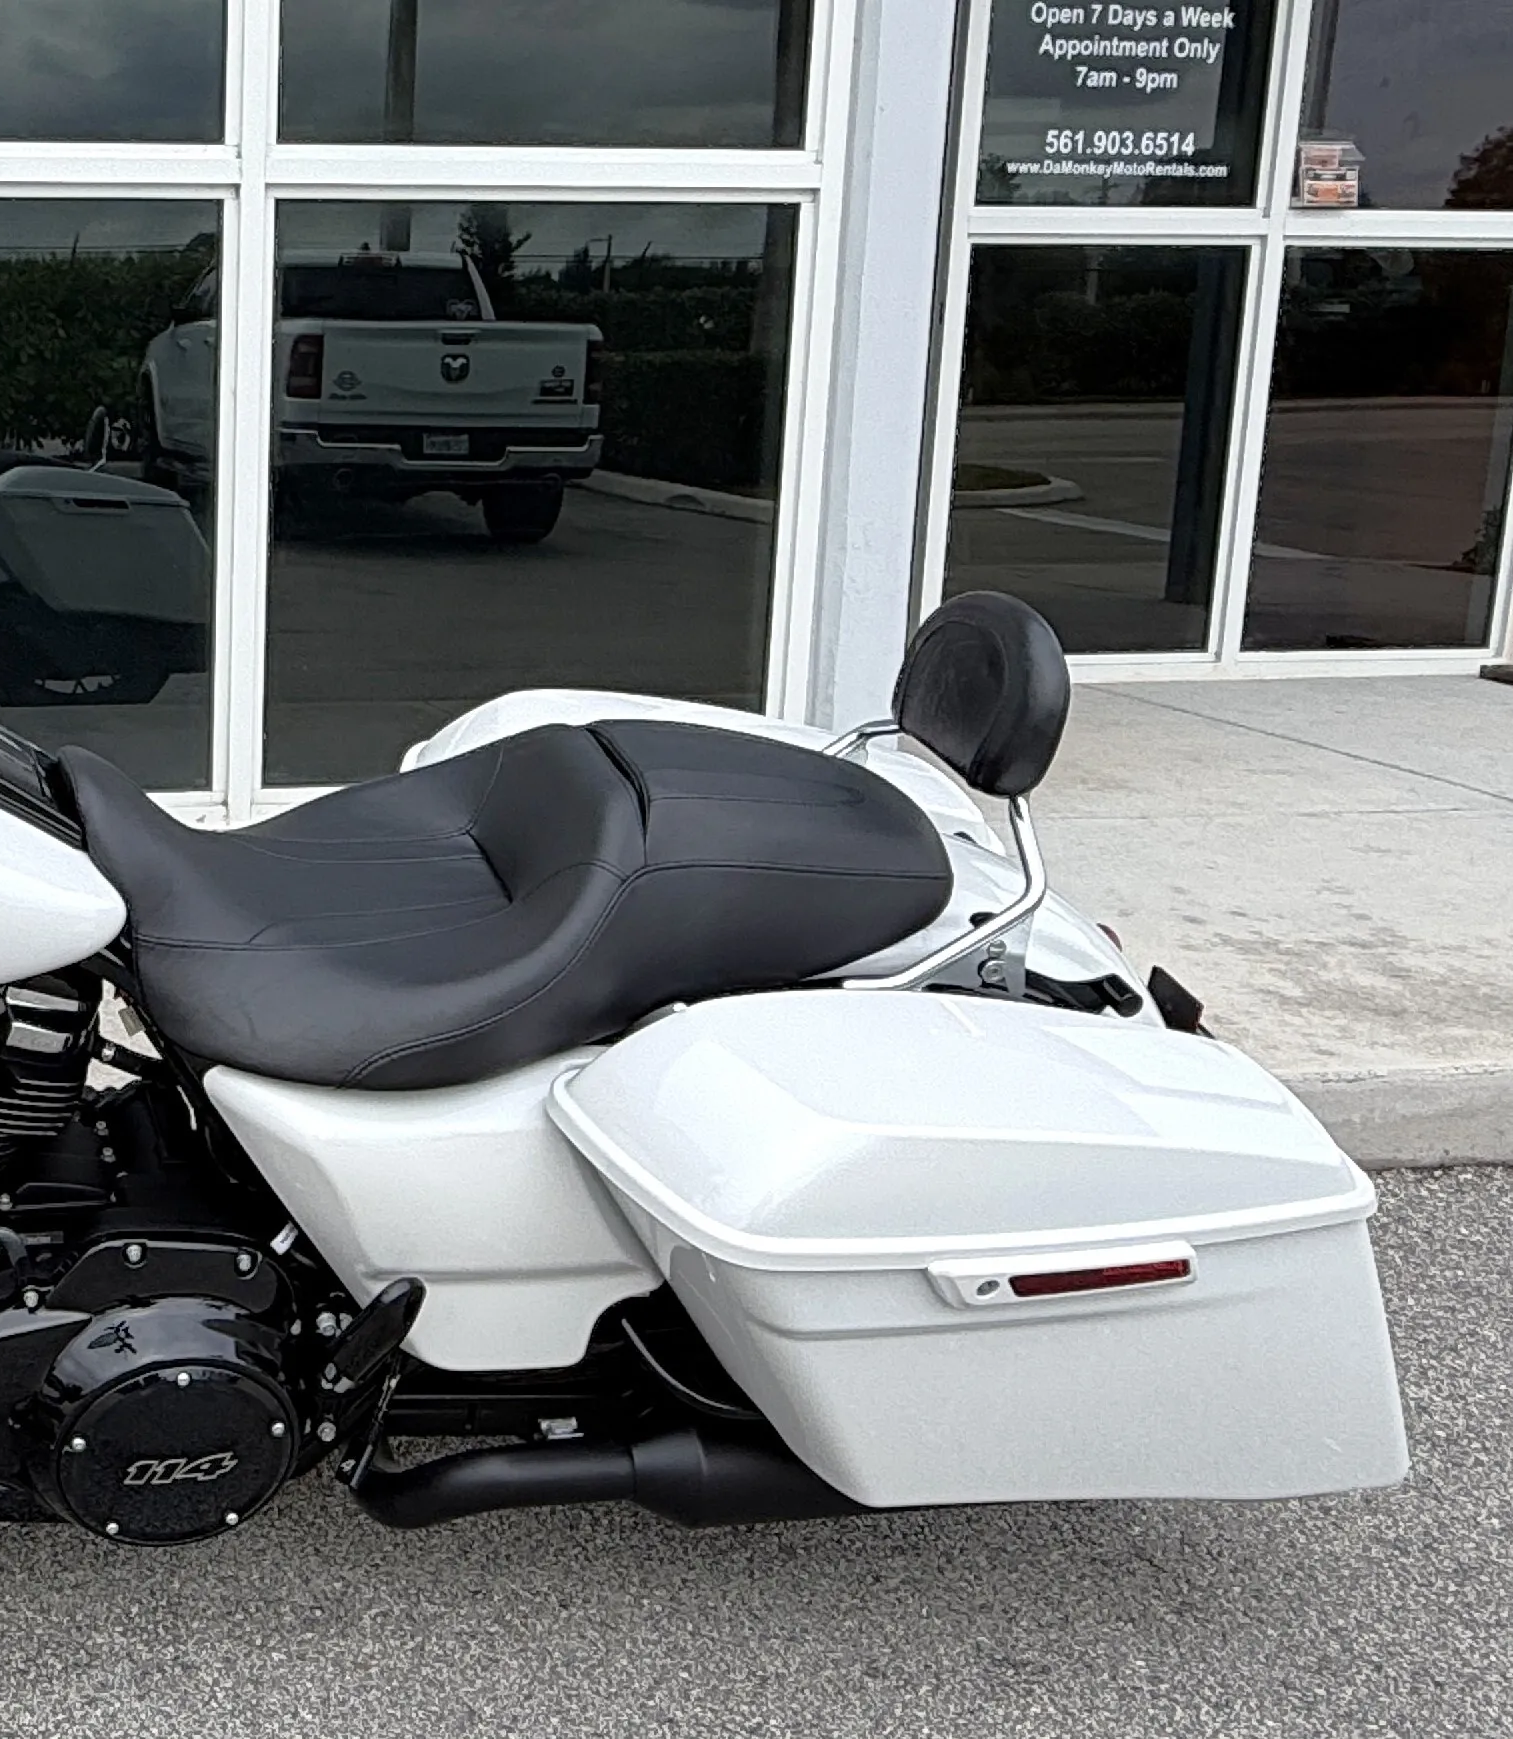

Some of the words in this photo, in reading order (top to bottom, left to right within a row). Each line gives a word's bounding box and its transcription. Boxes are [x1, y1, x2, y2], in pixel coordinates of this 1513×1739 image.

[1031, 2, 1085, 28] Open
[1090, 4, 1103, 25] 7
[1107, 4, 1158, 31] Days
[1162, 10, 1175, 27] a
[1180, 6, 1236, 29] Week
[1038, 33, 1169, 61] Appointment
[1174, 36, 1221, 64] Only
[1075, 66, 1117, 88] 7am
[1135, 67, 1178, 94] 9pm
[1044, 129, 1196, 157] 561.903.6514
[1006, 159, 1229, 179] www.DaMonkeyMotoRentals.com
[122, 1450, 239, 1487] 114
